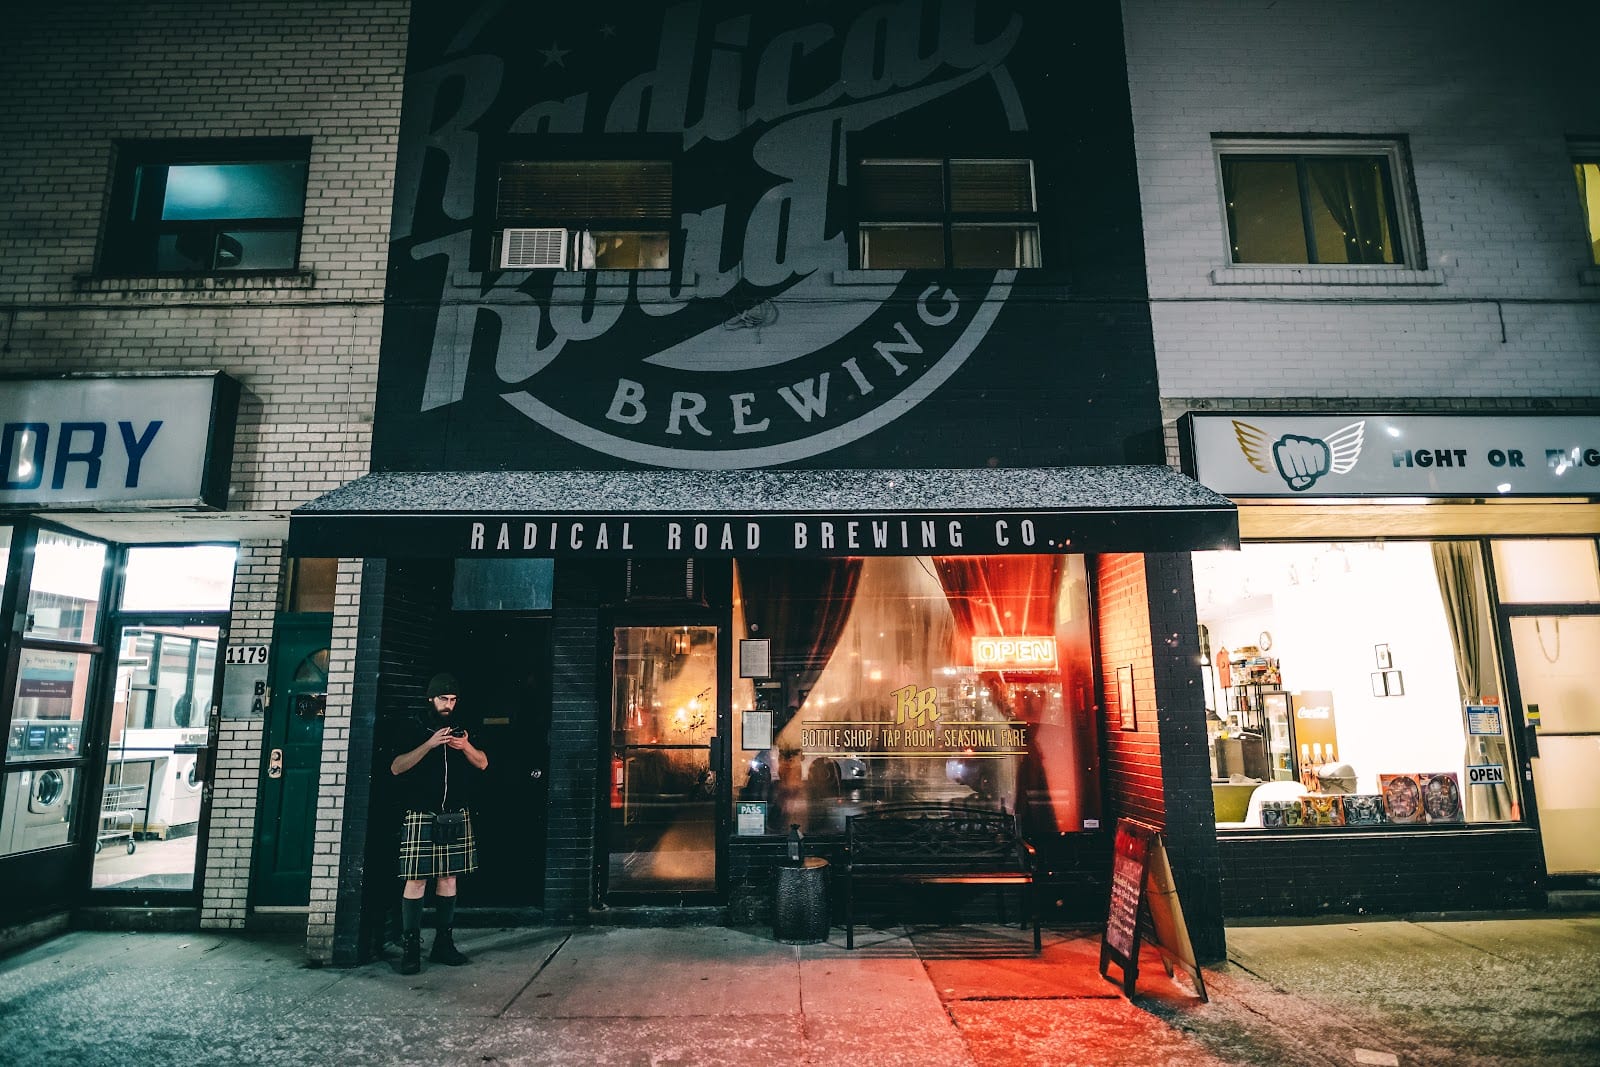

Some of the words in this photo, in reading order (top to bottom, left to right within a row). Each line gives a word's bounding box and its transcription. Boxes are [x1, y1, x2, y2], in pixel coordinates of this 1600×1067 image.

[605, 281, 961, 437] BREWING
[0, 420, 164, 491] DRY
[1487, 449, 1526, 468] OR
[470, 522, 633, 550] RADICAL
[667, 522, 760, 550] ROAD
[794, 520, 963, 549] BREWING
[995, 519, 1054, 546] CO.
[226, 646, 268, 664] 1179
[979, 640, 1053, 661] OPEN
[254, 681, 266, 696] B
[251, 698, 264, 713] A
[801, 729, 841, 747] BOTTLE
[843, 729, 873, 747] SHOP
[882, 729, 901, 747] TAP
[904, 729, 936, 747] ROOM
[944, 729, 998, 747] SEASONAL
[1001, 729, 1028, 747] FARE
[1469, 768, 1502, 781] OPEN
[741, 806, 762, 814] PASS
